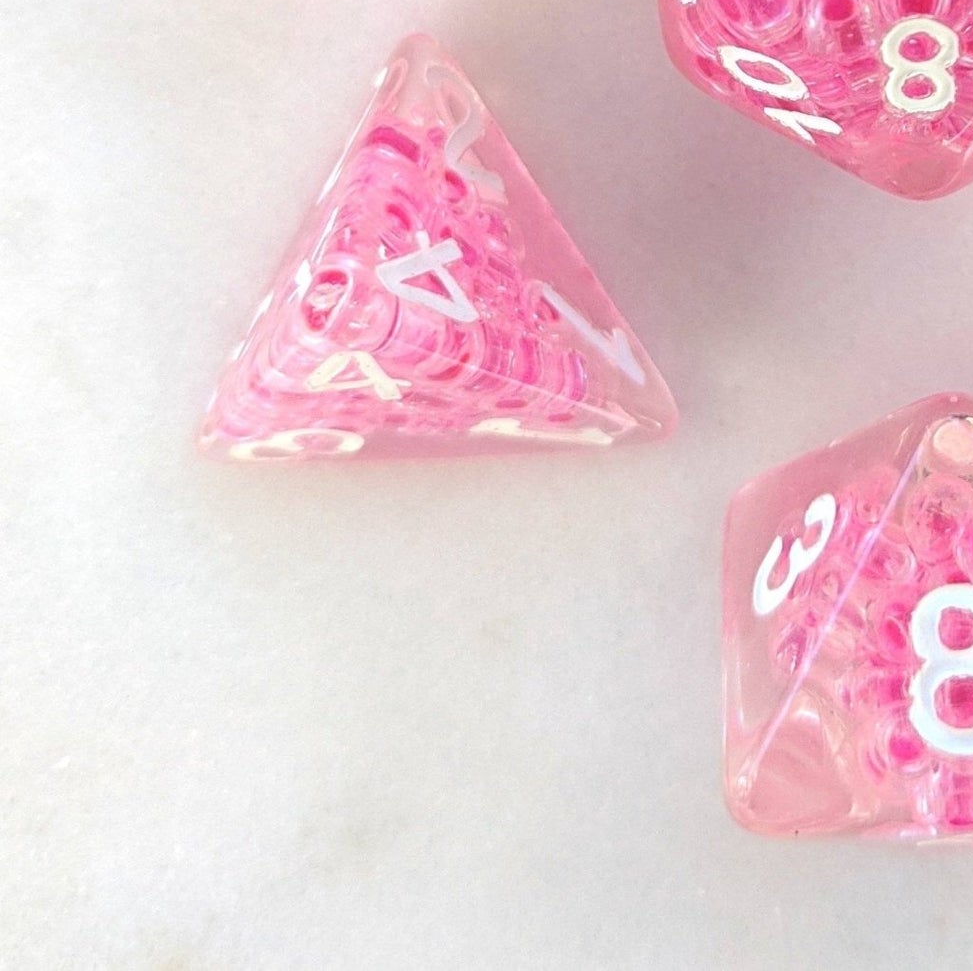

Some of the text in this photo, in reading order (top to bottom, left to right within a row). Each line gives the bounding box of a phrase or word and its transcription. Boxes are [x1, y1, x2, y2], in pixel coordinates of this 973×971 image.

[717, 44, 844, 144] 10
[879, 15, 961, 114] 8
[375, 228, 480, 324] 4
[304, 349, 413, 401] 4
[752, 492, 837, 617] 3
